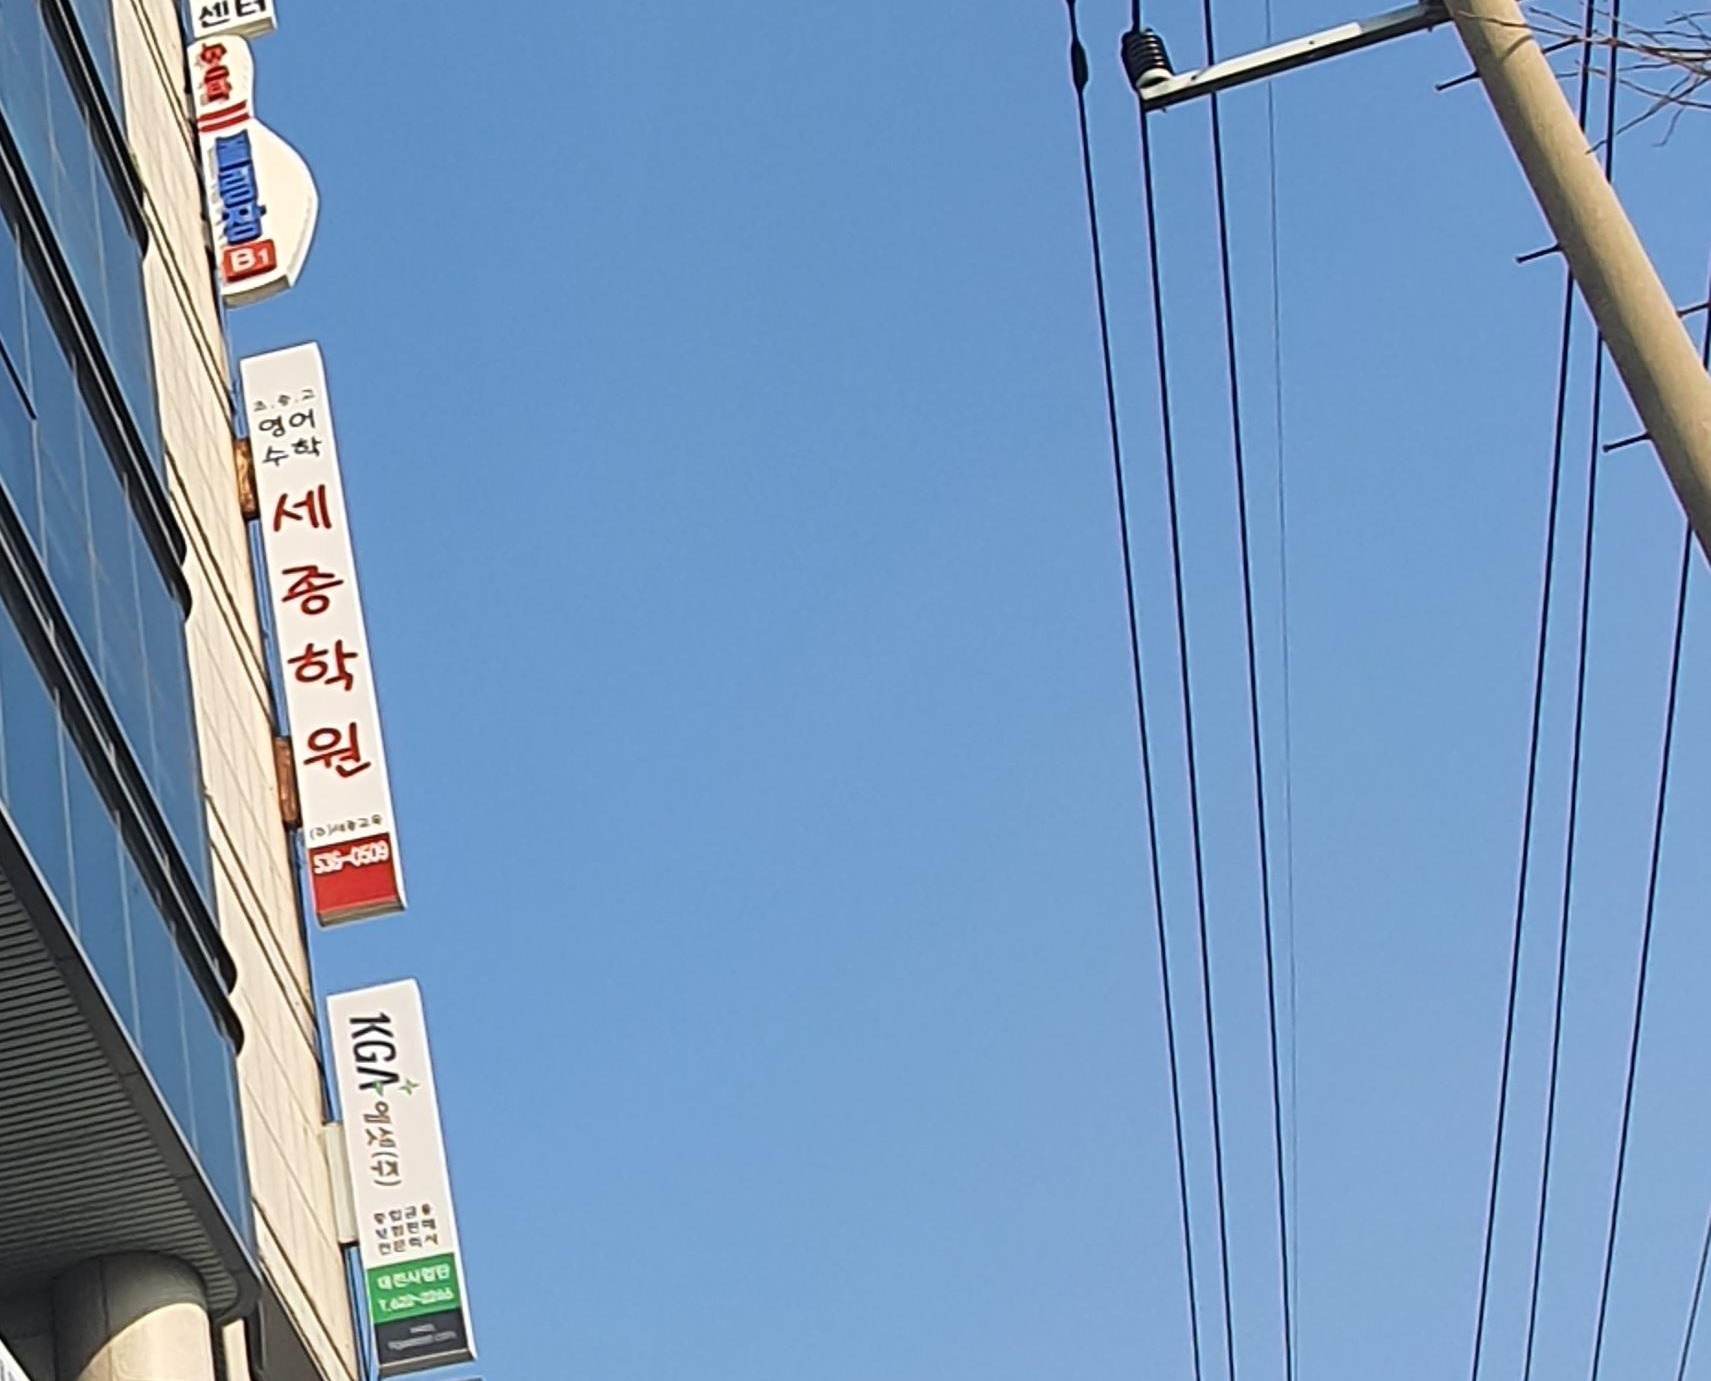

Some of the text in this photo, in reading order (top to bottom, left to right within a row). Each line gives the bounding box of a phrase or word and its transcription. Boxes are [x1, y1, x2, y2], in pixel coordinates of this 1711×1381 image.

[229, 243, 270, 273] B1
[259, 408, 316, 437] 영어
[263, 436, 322, 466] 수학
[272, 484, 371, 779] 세종학원
